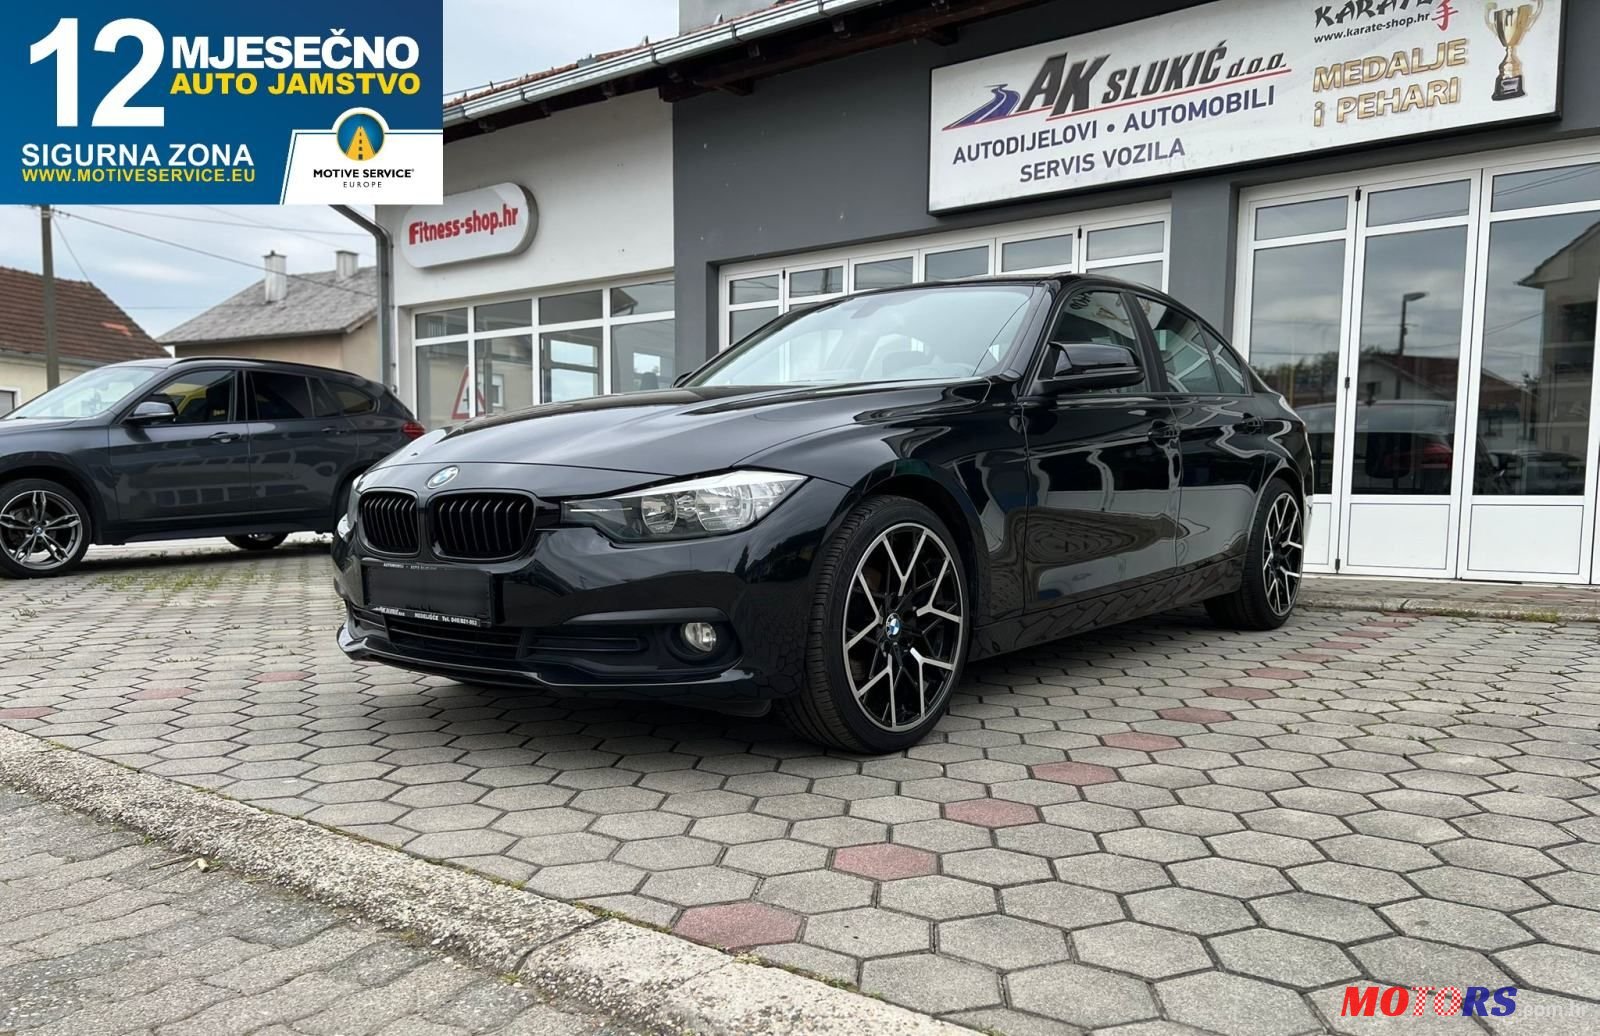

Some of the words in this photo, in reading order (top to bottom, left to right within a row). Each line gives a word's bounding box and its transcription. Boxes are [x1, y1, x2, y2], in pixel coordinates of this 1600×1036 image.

[1314, 12, 1430, 44] www.karate-shop.hr
[1015, 52, 1111, 117] AK
[1101, 39, 1228, 104] SLUKIĆ
[1313, 38, 1469, 92] MEDALJE
[953, 120, 1098, 165] AUTODIJELOVI
[1123, 85, 1275, 133] AUTOMOBILI
[1313, 101, 1326, 127] i
[1336, 77, 1461, 123] PEHARI
[1020, 153, 1095, 183] SERVIS
[1104, 138, 1186, 169] VOZILA
[408, 203, 519, 245] Fitness-shop.hr
